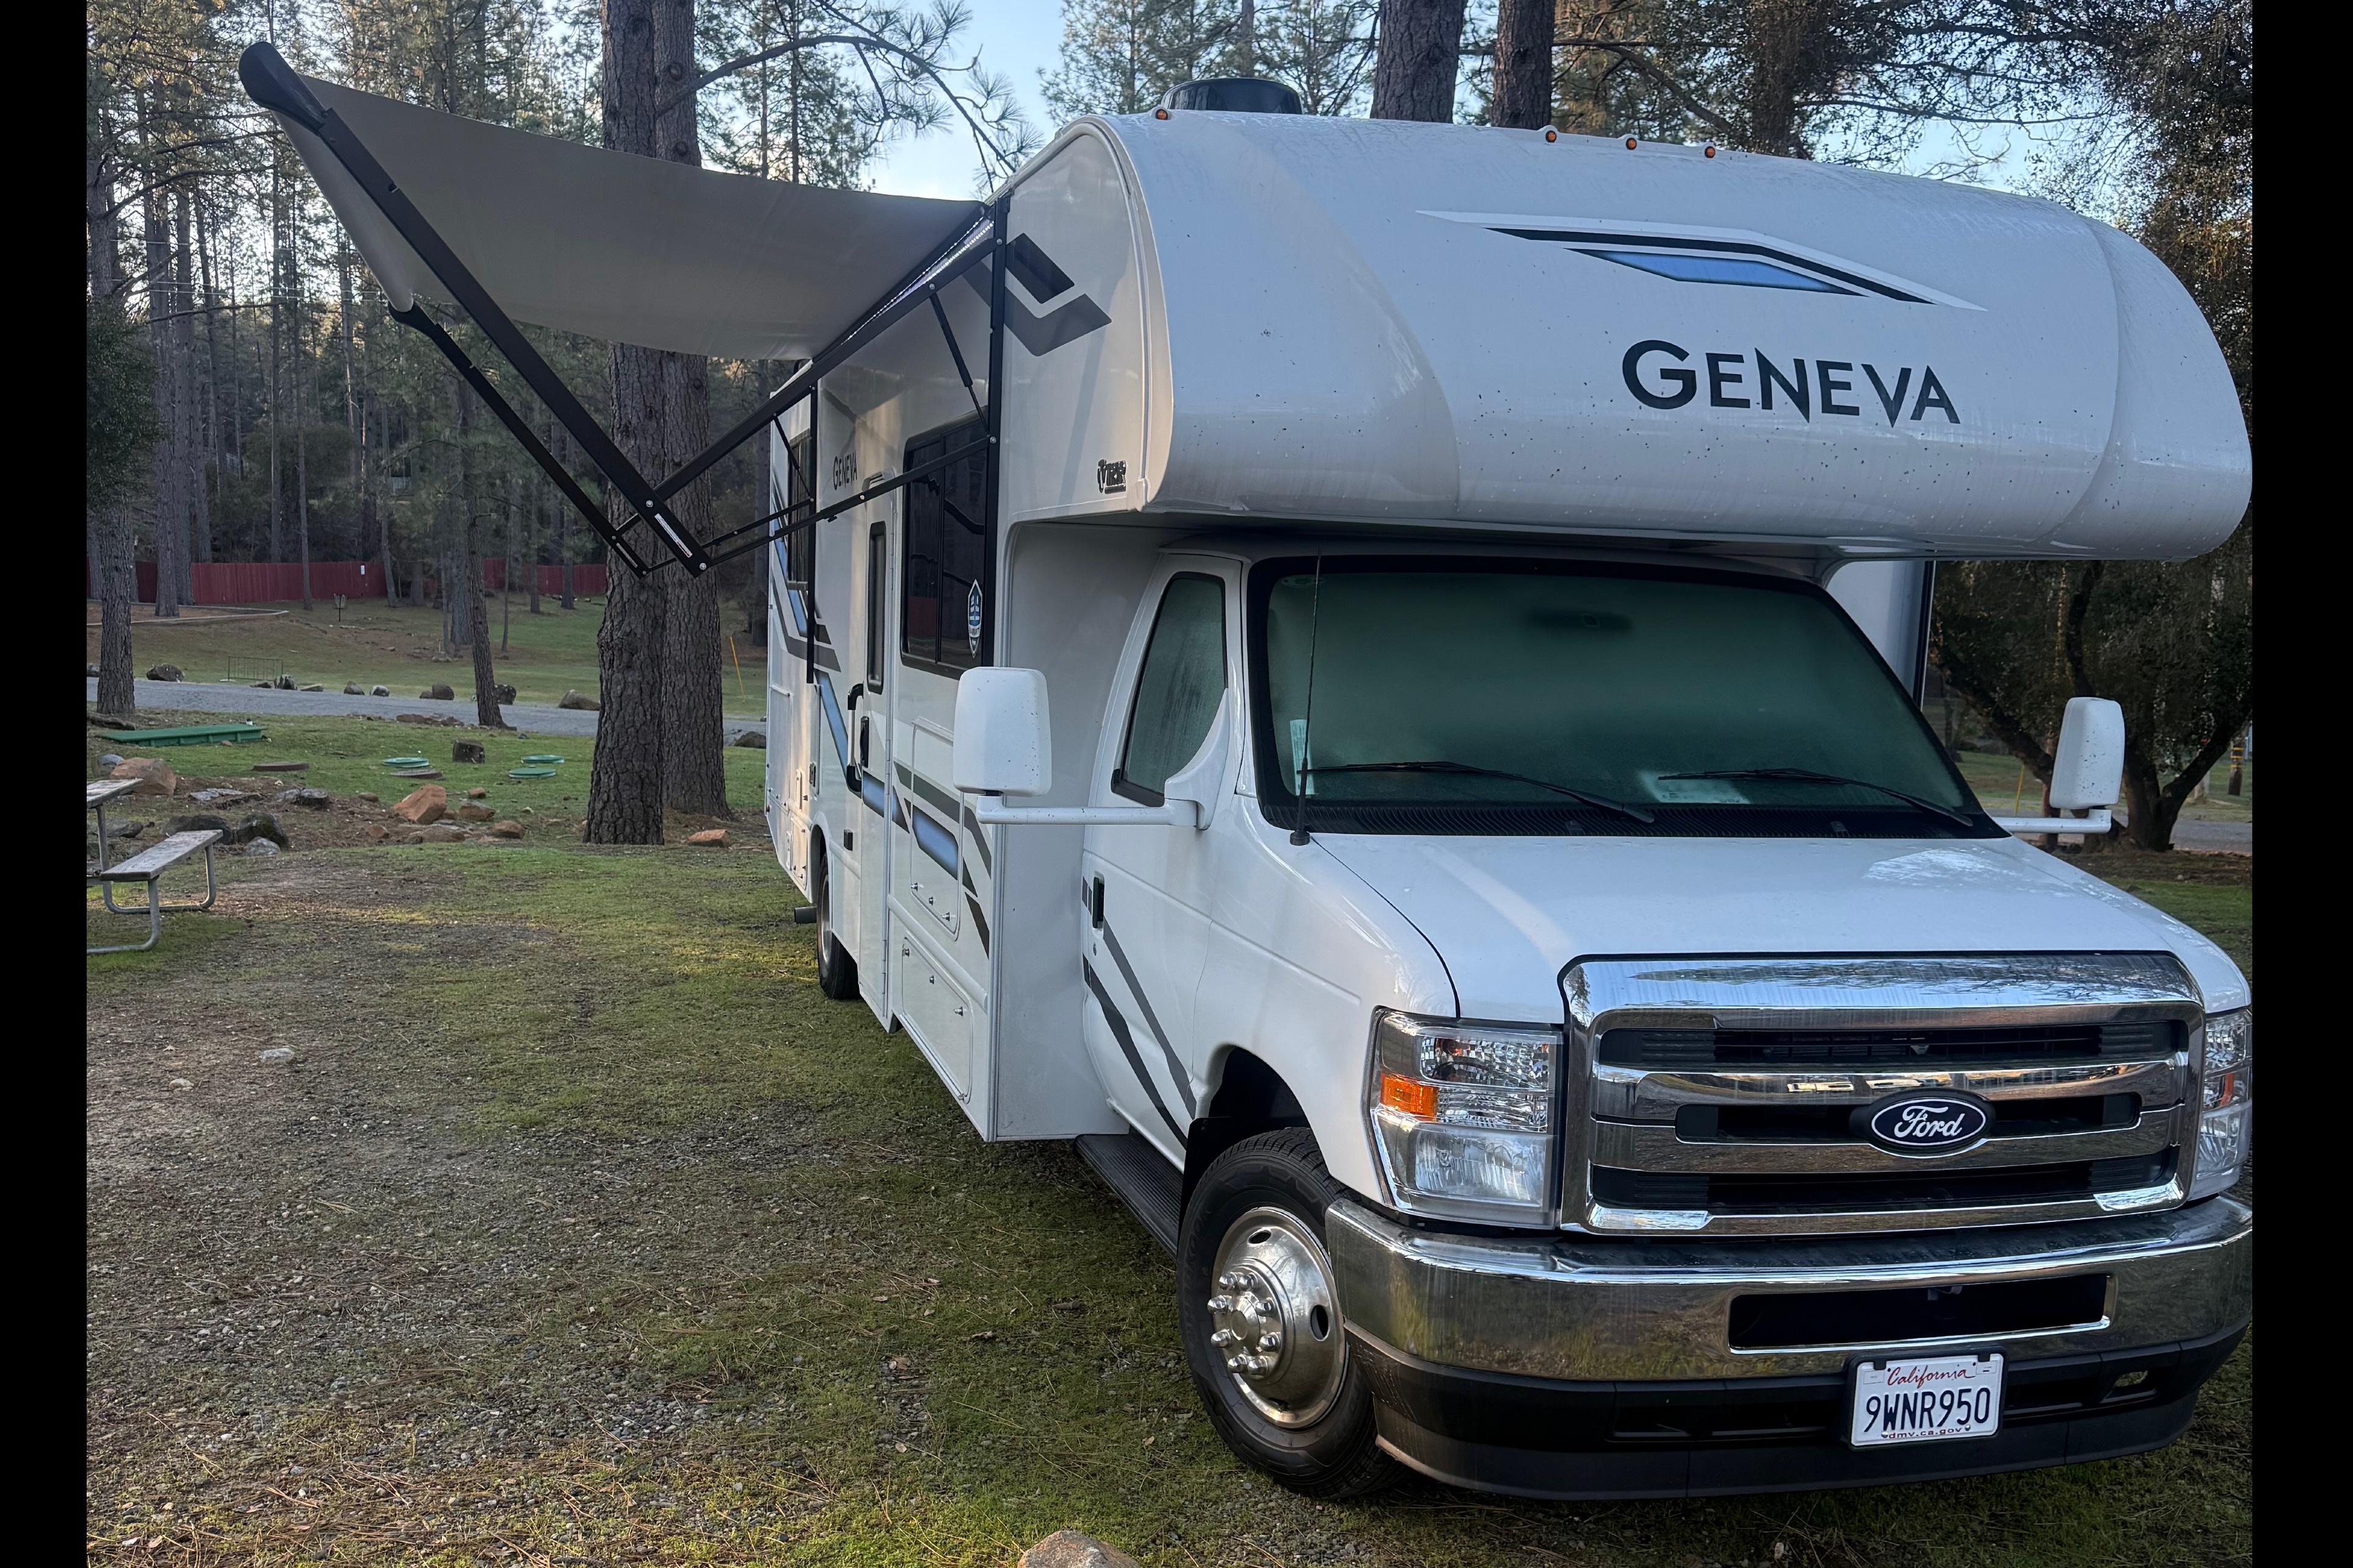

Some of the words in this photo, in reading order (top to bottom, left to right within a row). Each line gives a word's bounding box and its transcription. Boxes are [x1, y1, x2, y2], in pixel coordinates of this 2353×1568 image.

[1622, 339, 1960, 428] GENEVA
[833, 450, 857, 490] GENEVA
[1894, 1105, 1965, 1138] Ford
[1887, 1365, 1976, 1389] California
[1864, 1387, 1990, 1433] 9WNR950
[1888, 1426, 1962, 1439] dmv.ca.gov
